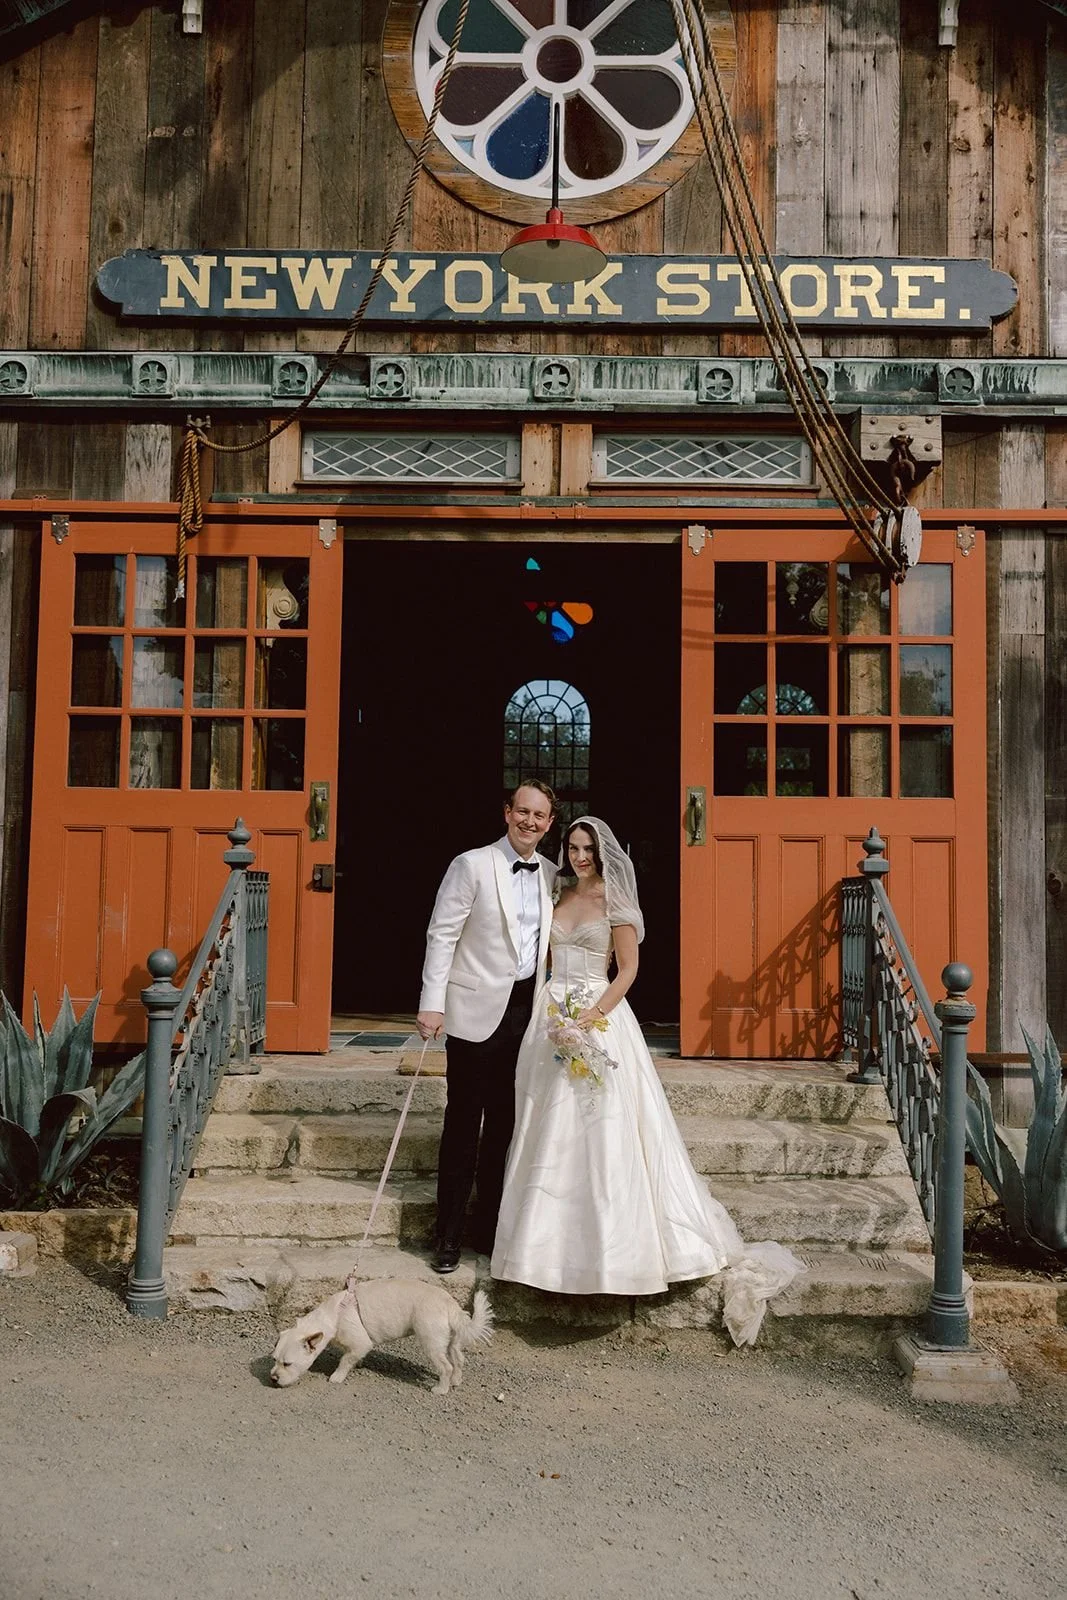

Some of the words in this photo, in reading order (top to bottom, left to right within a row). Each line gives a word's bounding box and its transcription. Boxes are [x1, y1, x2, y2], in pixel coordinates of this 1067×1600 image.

[159, 255, 352, 311] NEW
[371, 258, 623, 315] YORK
[655, 263, 971, 320] STORE.
